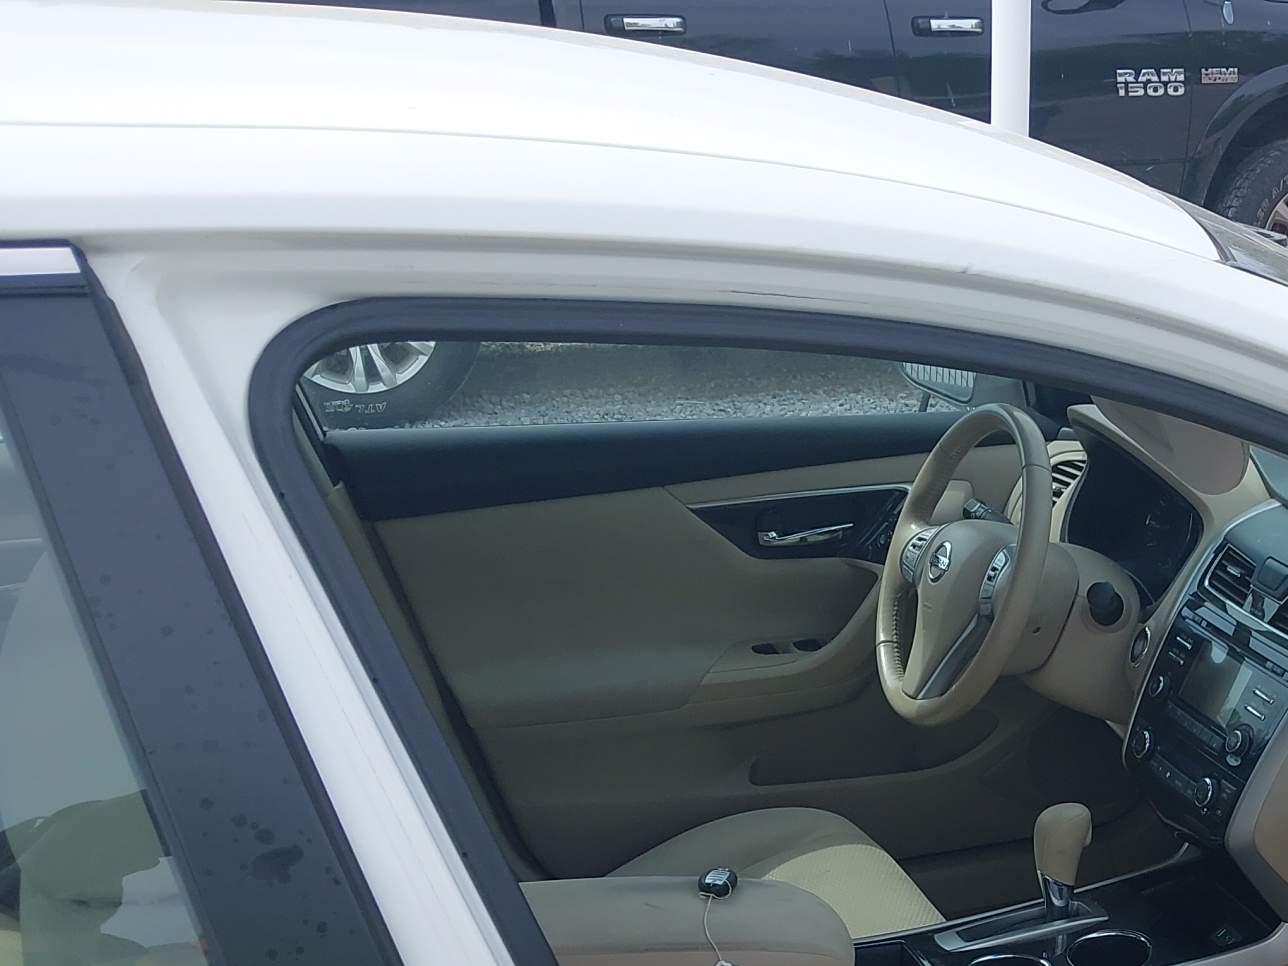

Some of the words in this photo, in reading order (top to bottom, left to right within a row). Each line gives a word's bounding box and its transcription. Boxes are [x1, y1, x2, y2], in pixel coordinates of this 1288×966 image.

[1115, 68, 1185, 82] RAM
[1200, 67, 1238, 75] HEMI
[1116, 83, 1185, 97] 1500
